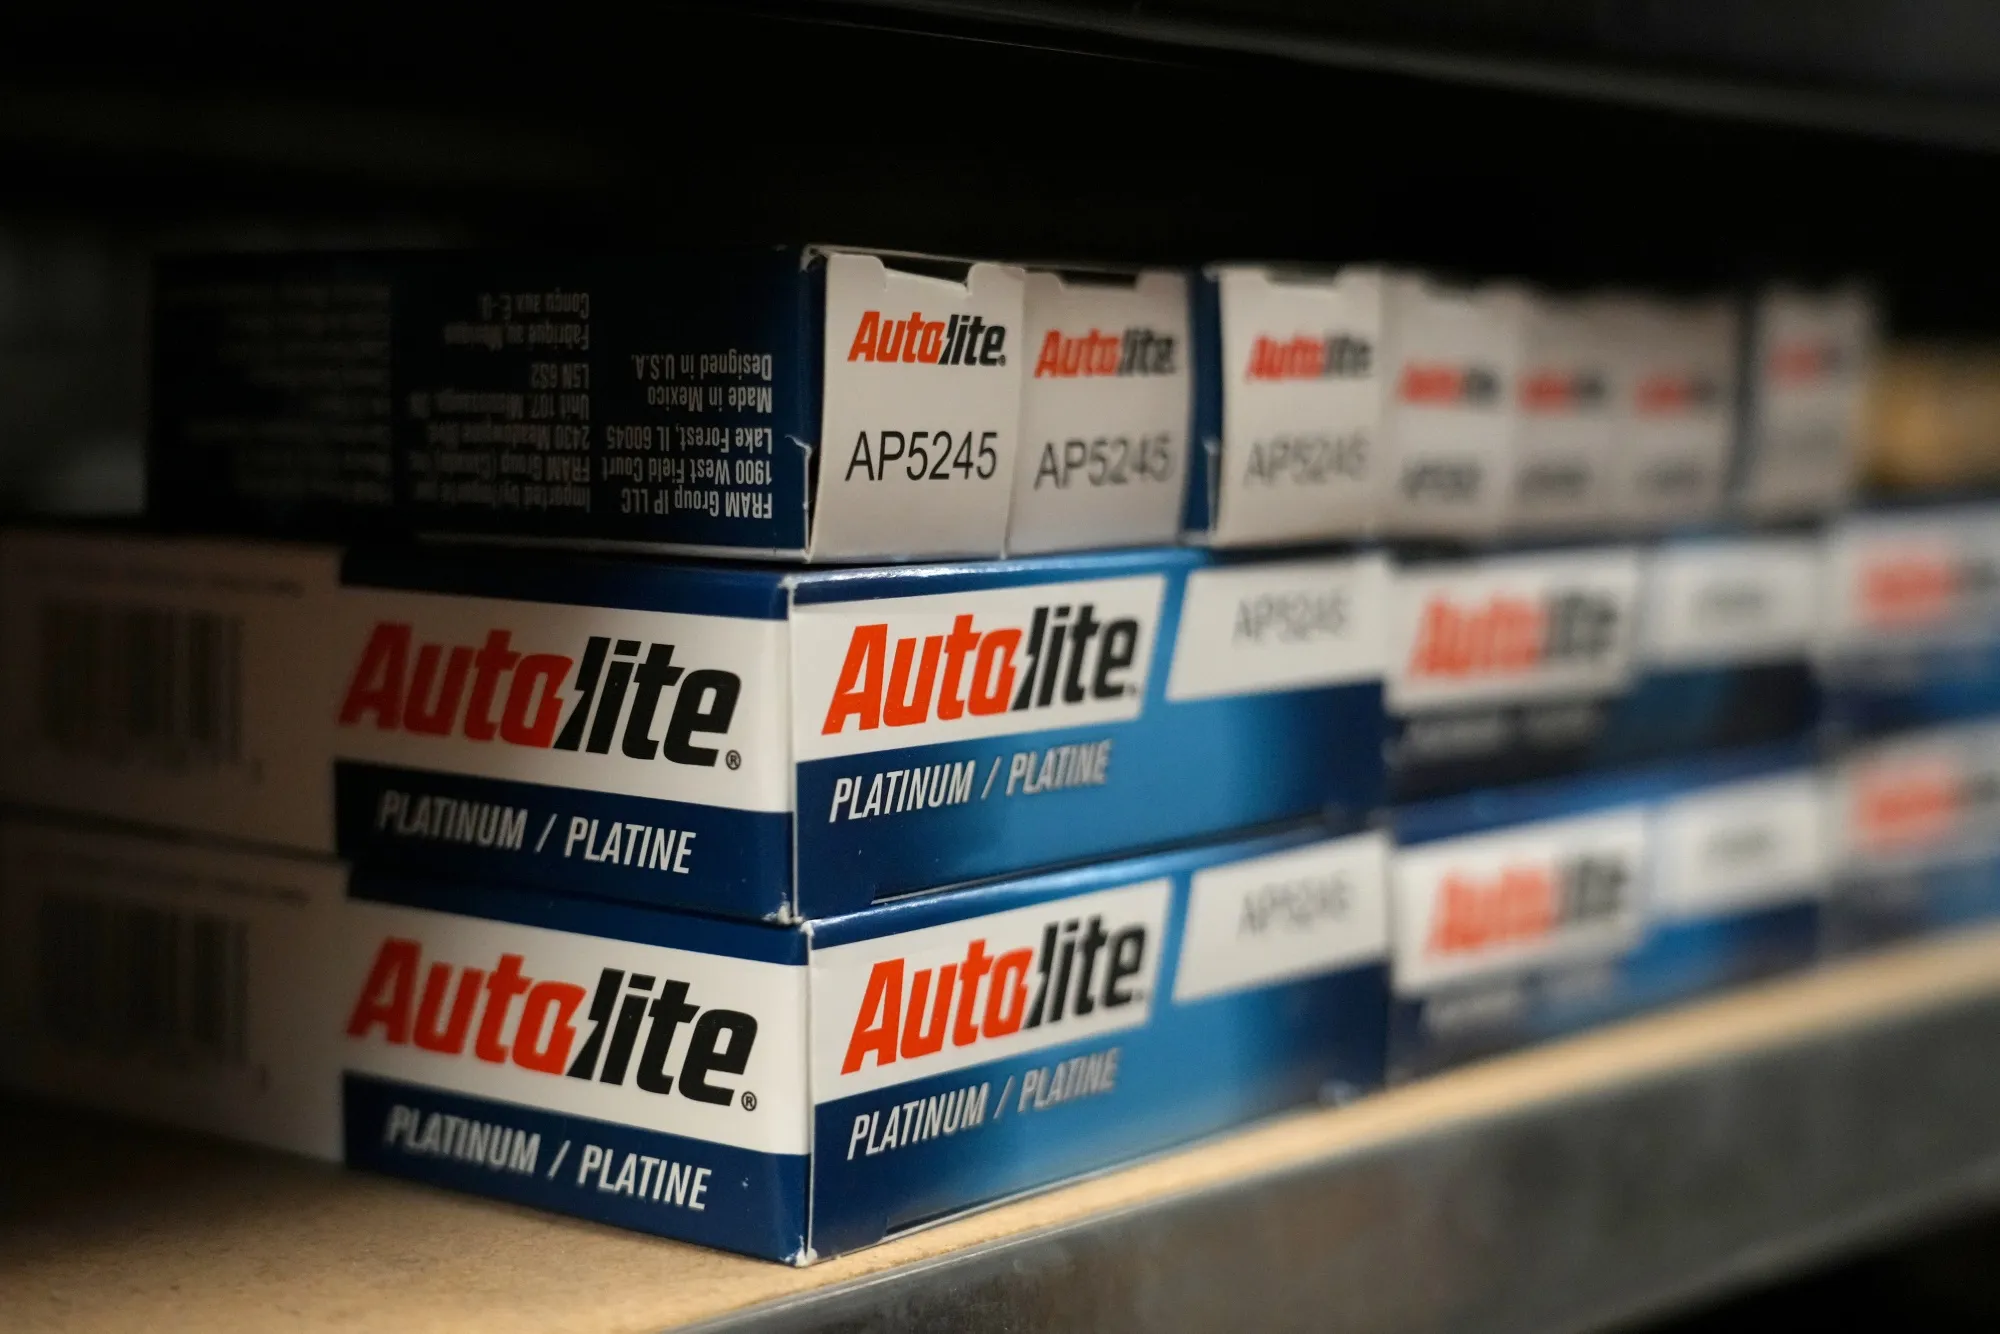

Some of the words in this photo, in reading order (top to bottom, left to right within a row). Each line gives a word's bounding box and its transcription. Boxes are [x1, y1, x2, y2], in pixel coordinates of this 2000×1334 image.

[847, 311, 1005, 366] Autolite
[632, 354, 675, 380] U.S.A.
[680, 354, 694, 380] in
[700, 348, 772, 381] Designed
[1034, 329, 1175, 378] Autolite
[647, 386, 703, 413] Mexico
[709, 387, 722, 412] in
[728, 386, 772, 413] Made
[606, 426, 651, 450] 60045
[656, 426, 669, 451] IL
[675, 423, 729, 454] Forest,
[735, 427, 772, 454] Lake
[546, 455, 590, 482] FRAM
[601, 456, 643, 483] Court
[845, 430, 998, 481] AP5245
[1034, 431, 1173, 489] AP5245
[649, 456, 685, 484] Field
[689, 458, 730, 486] West
[735, 459, 772, 486] 1900
[621, 488, 649, 514] LLC
[654, 489, 669, 515] IP
[674, 485, 719, 517] Group
[725, 491, 772, 519] FRAM
[821, 604, 1139, 736] Autolite
[337, 621, 741, 767] Autolite
[829, 760, 976, 823] PLATINUM
[1007, 740, 1113, 797] PLATINE
[377, 790, 528, 851] PLATINUM
[565, 816, 696, 874] PLATINE
[841, 914, 1148, 1075] Autolite
[346, 936, 758, 1106] Autolite
[847, 1083, 990, 1161] PLATINUM
[1018, 1047, 1123, 1114] PLATINE
[386, 1105, 541, 1175] PLATINUM
[576, 1145, 712, 1210] PLATINE
